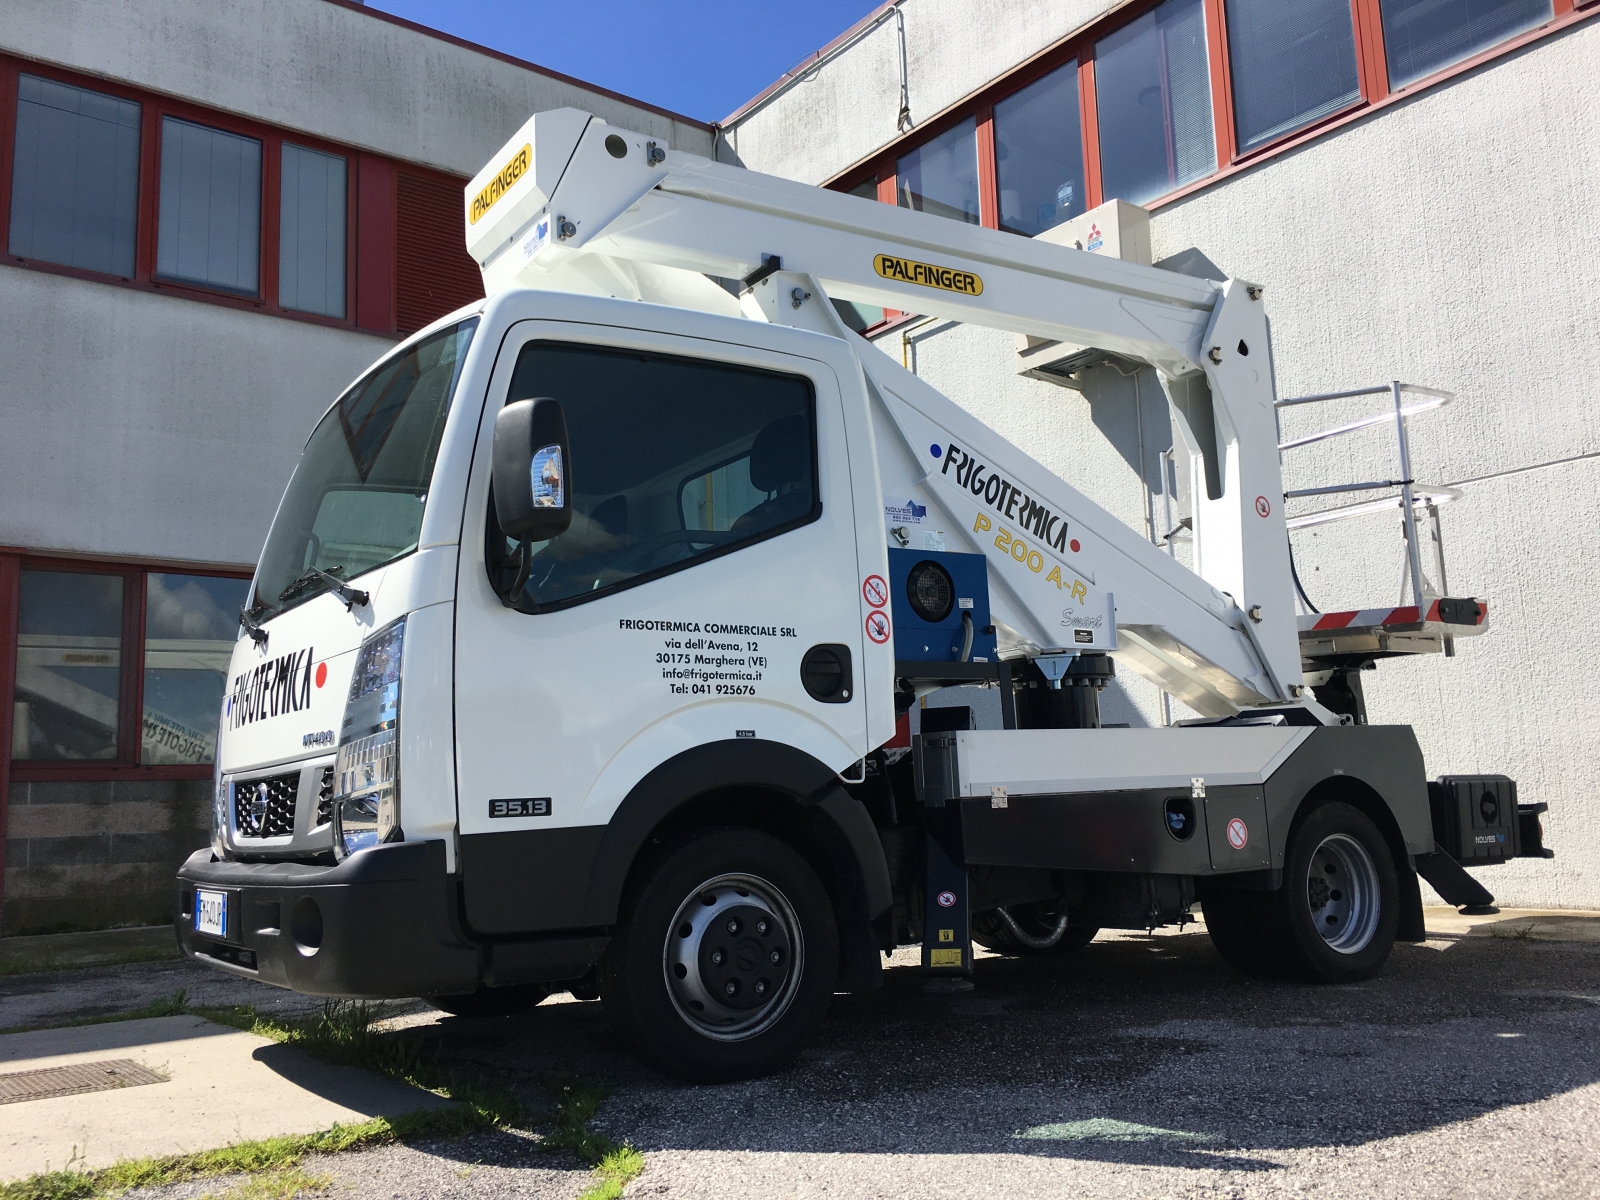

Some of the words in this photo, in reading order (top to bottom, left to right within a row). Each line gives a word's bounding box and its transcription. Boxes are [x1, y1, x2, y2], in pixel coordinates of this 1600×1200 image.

[473, 149, 528, 222] PALFINGER
[881, 257, 976, 293] PALFINGER
[941, 443, 1069, 554] FRIGOTERMICA
[973, 512, 992, 533] P
[994, 527, 1044, 573] 200
[1046, 566, 1088, 605] A-R
[1061, 608, 1102, 628] Smart
[619, 619, 701, 633] FRIGOTERMICA
[704, 623, 777, 637] COMMERCIALE
[780, 627, 797, 638] SRL
[665, 639, 682, 649] via
[685, 639, 743, 652] dell'Avena,
[746, 641, 759, 652] 12
[656, 653, 691, 664] 30175
[694, 654, 745, 669] Marghera
[748, 656, 767, 669] (VE)
[662, 668, 763, 682] info@frigotermica.it
[229, 646, 314, 731] FRIGOTERMICA
[670, 683, 689, 694] Tel:
[691, 684, 712, 695] 041
[716, 684, 756, 695] 925676
[494, 800, 547, 815] 35.13
[1475, 835, 1496, 844] NOLVES
